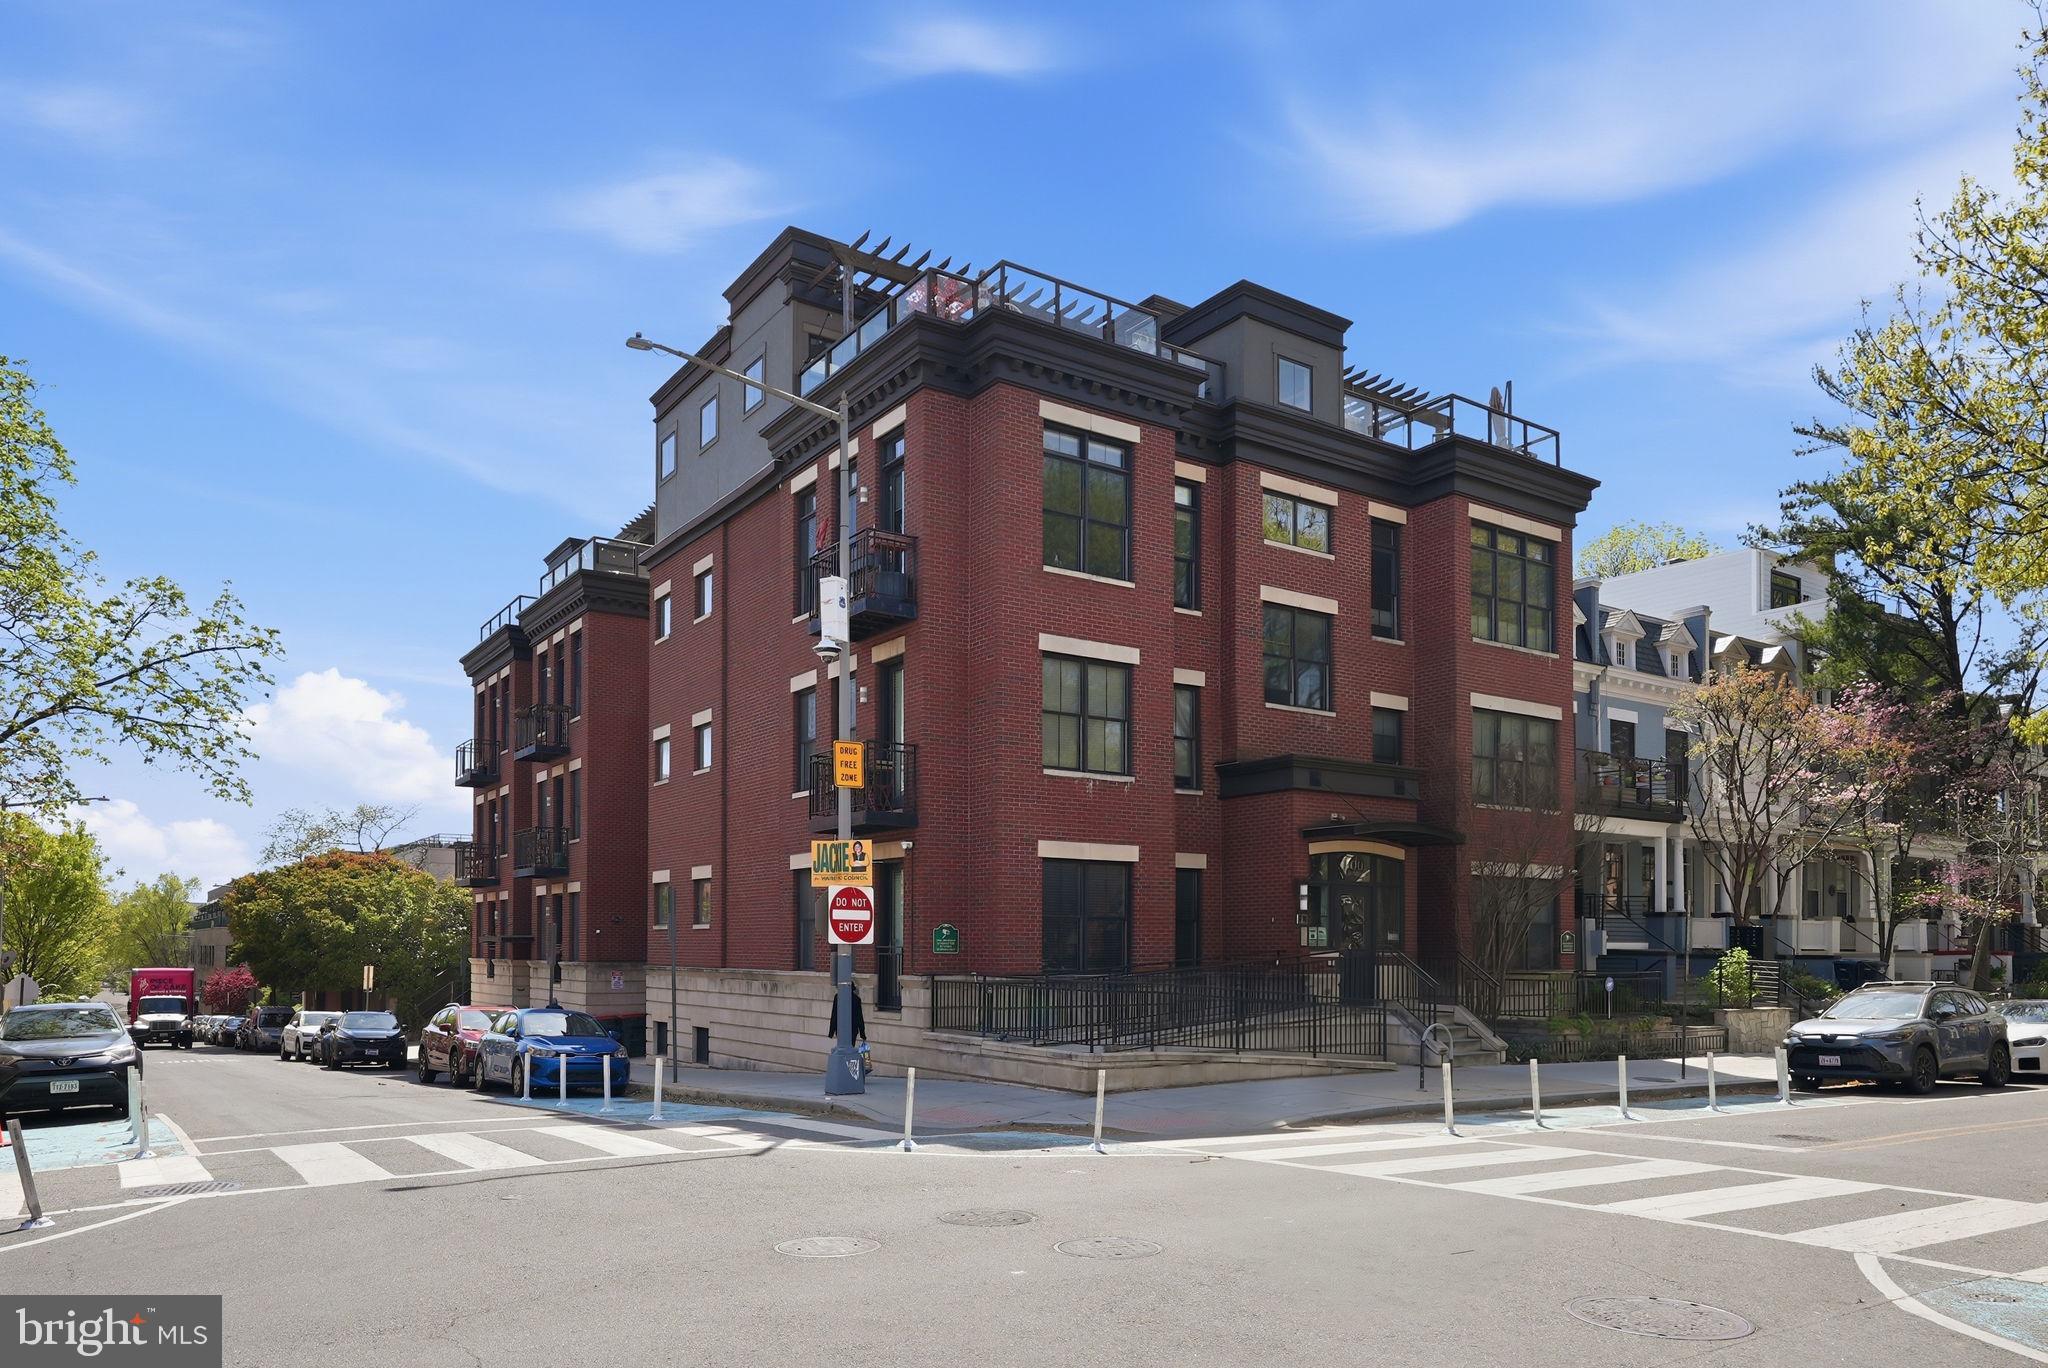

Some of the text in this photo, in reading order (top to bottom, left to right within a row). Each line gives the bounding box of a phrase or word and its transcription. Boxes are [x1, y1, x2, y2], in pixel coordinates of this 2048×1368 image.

[840, 746, 858, 756] DRUG
[840, 760, 858, 769] FREE
[840, 773, 858, 782] ZONE
[836, 897, 868, 908] DO NOT
[838, 922, 865, 933] ENTER
